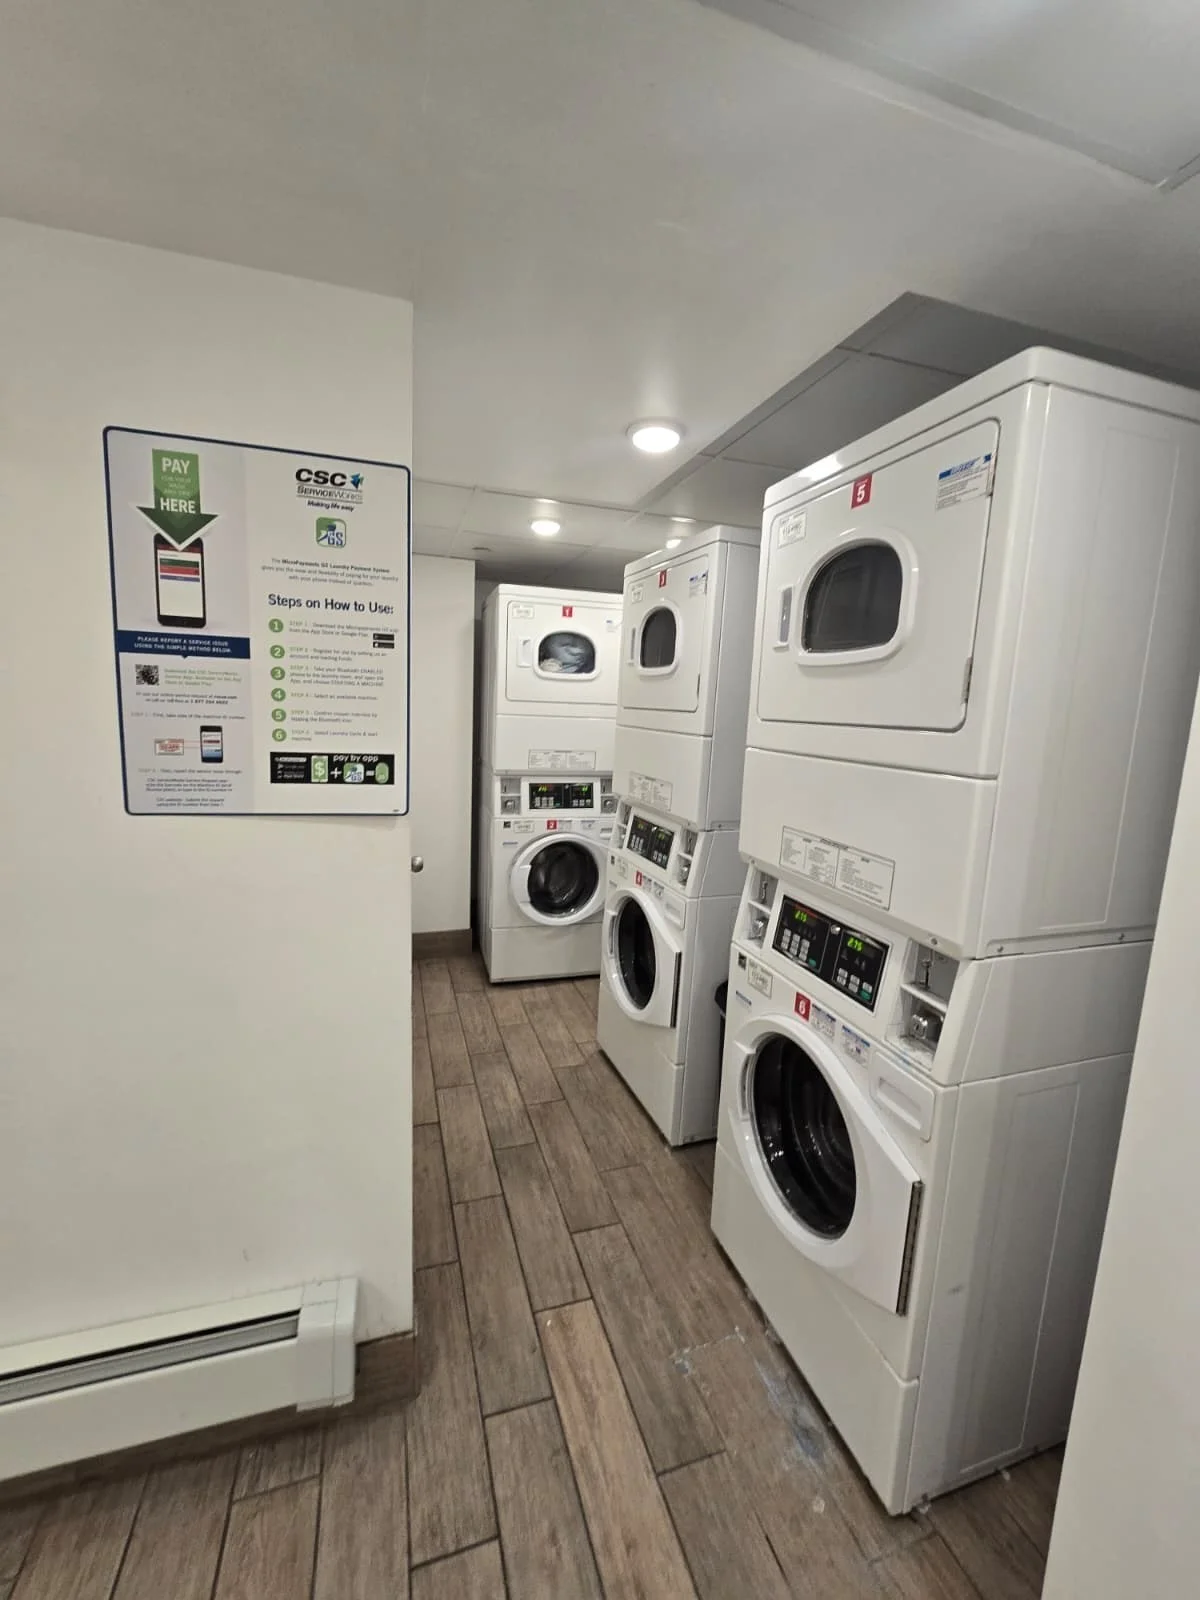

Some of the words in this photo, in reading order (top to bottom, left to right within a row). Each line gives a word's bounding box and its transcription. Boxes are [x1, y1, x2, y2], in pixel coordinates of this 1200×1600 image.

[162, 458, 190, 474] PAY
[296, 468, 346, 486] CSC
[856, 485, 866, 502] 5
[160, 498, 196, 514] HERE
[308, 500, 330, 509] Making
[331, 501, 340, 509] life
[268, 594, 302, 609] Steps
[306, 598, 320, 608] on
[325, 598, 350, 611] How
[354, 601, 365, 612] to
[369, 602, 394, 614] Use:
[273, 622, 279, 630] 1
[274, 647, 282, 657] 2
[274, 690, 283, 699] 4
[275, 710, 282, 720] 5
[275, 730, 283, 739] 6
[333, 755, 348, 763] pay
